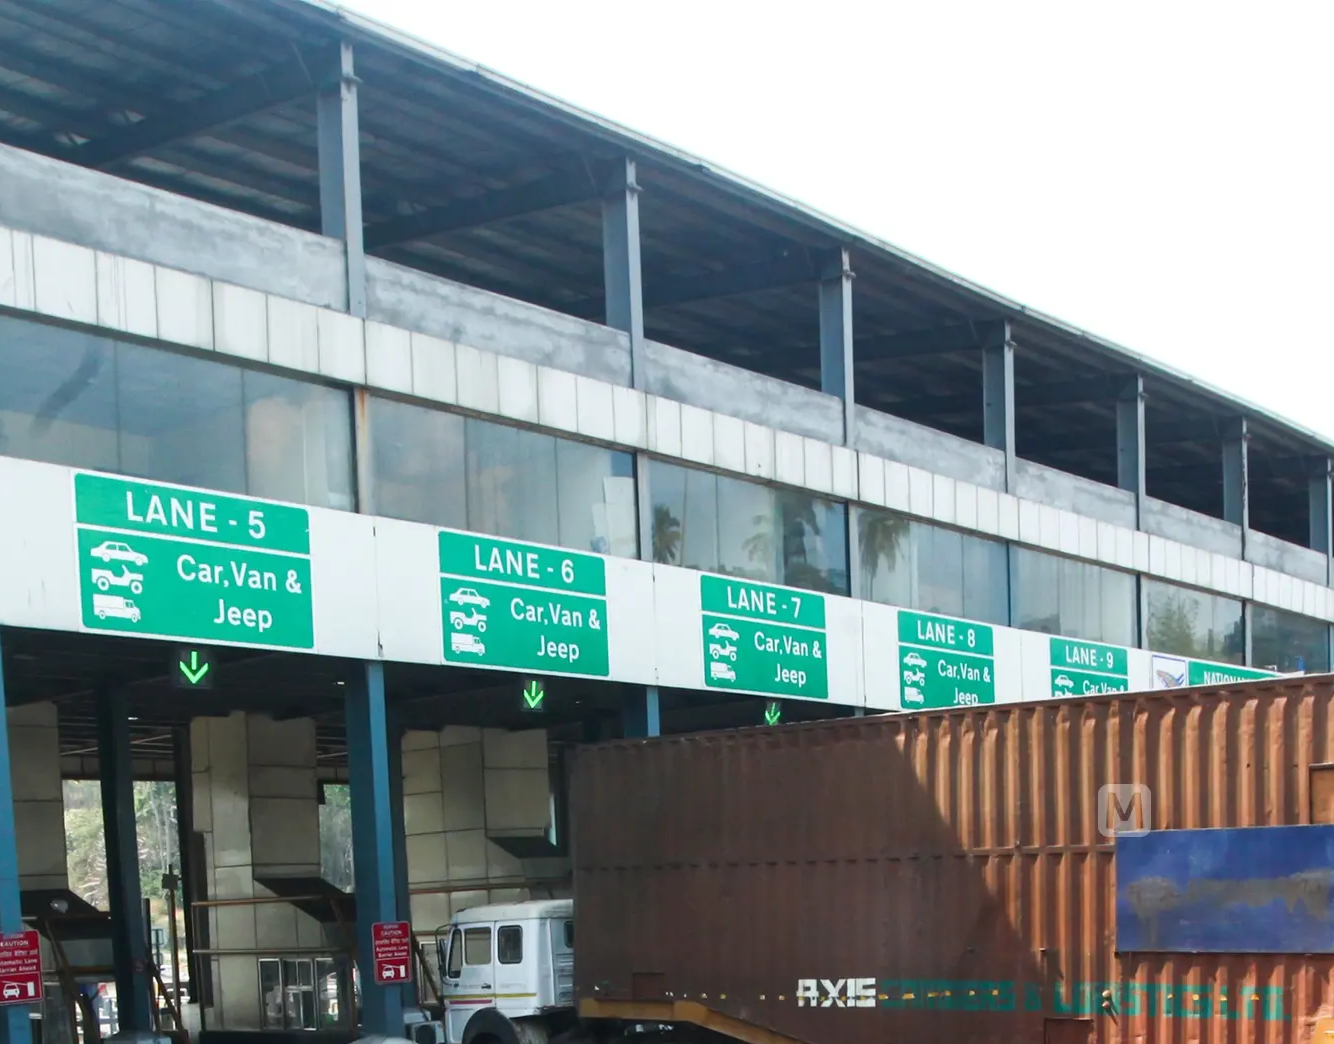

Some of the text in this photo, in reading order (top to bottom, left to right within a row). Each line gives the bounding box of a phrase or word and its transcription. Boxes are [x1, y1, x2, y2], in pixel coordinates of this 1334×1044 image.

[126, 490, 218, 533] LANE
[248, 509, 266, 539] 5
[474, 544, 540, 579] LANE
[561, 559, 575, 584] 6
[285, 569, 302, 594] &
[727, 586, 777, 615] LANE
[791, 596, 801, 618] 7
[213, 598, 273, 633] Jeep
[588, 608, 601, 630] &
[917, 620, 956, 645] LANE
[967, 628, 976, 648] 8
[537, 635, 580, 663] Jeep
[812, 640, 823, 659] &
[1065, 645, 1099, 667] LANE
[1106, 651, 1114, 669] 9
[774, 663, 807, 688] Jeep
[982, 666, 991, 683] &
[1203, 671, 1244, 684] NATIO
[953, 687, 979, 705] Jeep
[797, 978, 876, 1008] AXIS
